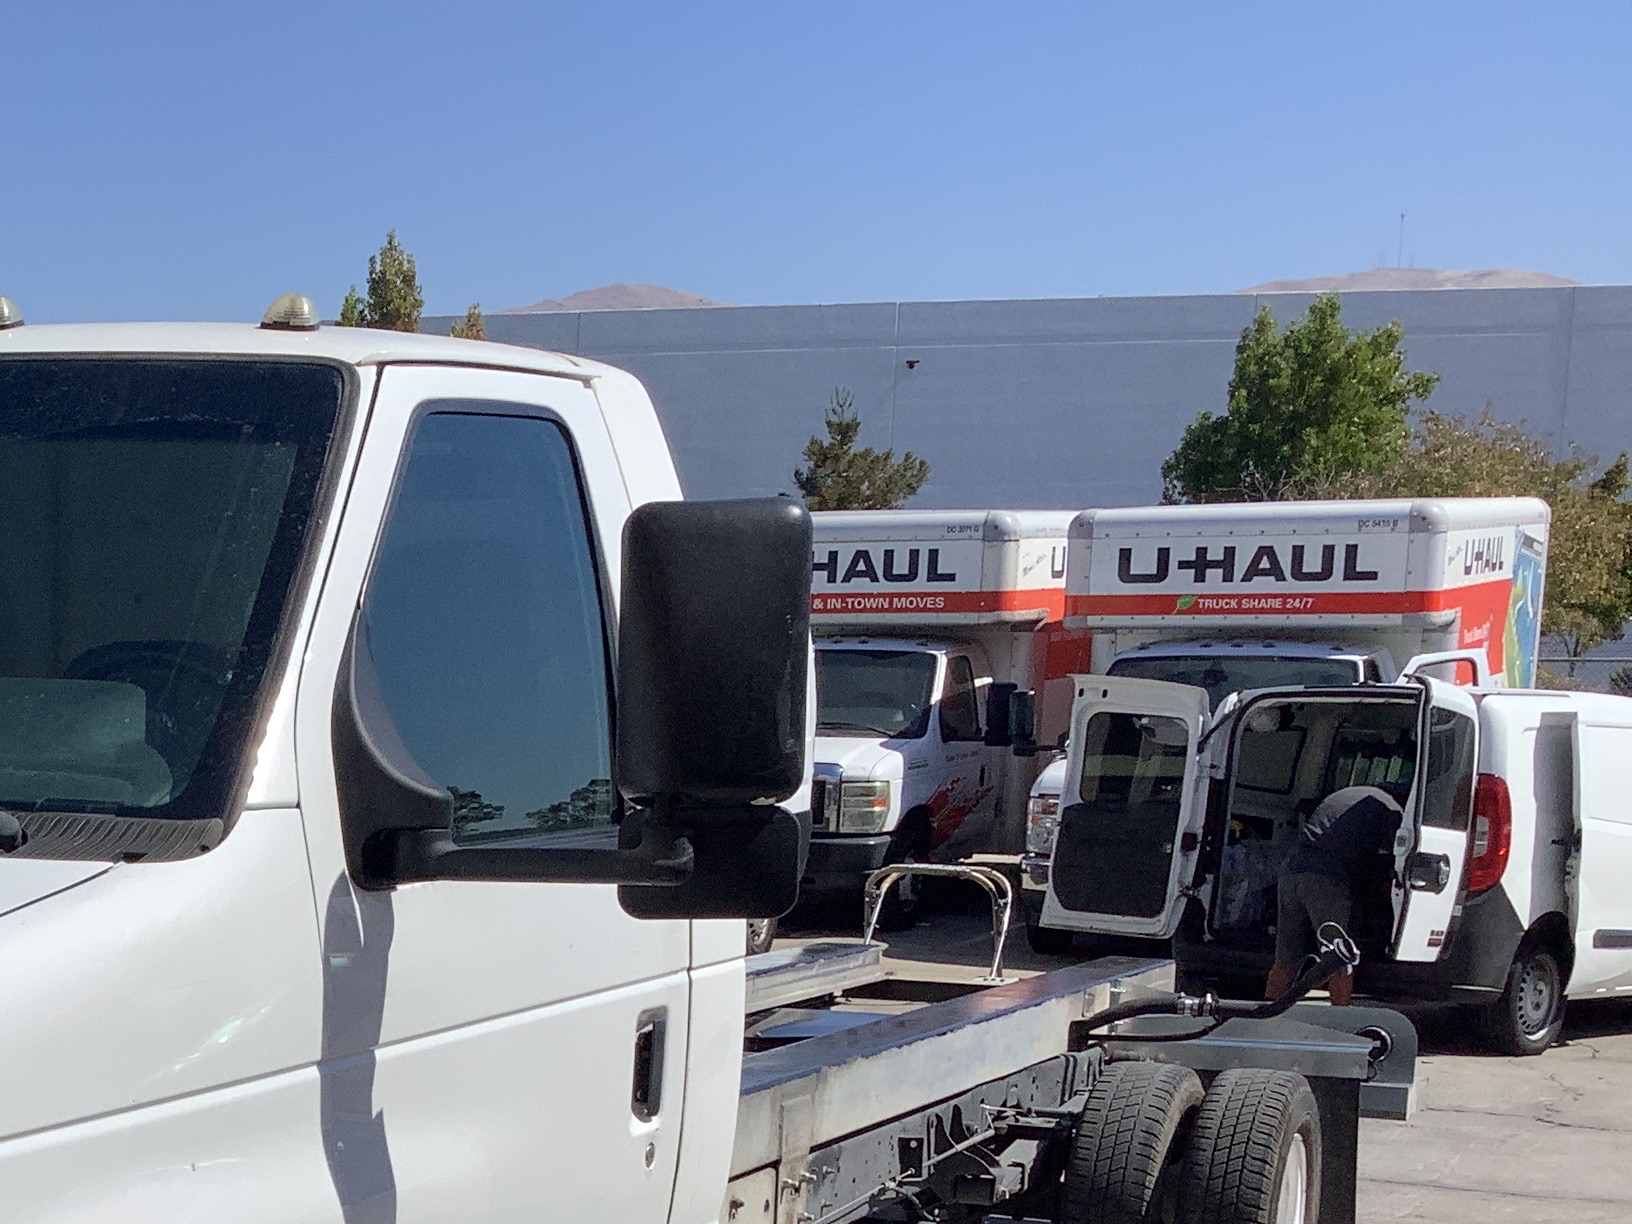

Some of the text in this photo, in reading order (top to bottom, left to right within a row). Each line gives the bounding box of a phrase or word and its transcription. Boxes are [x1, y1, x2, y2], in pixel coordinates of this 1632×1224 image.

[811, 548, 957, 584] HAUL
[1118, 543, 1379, 584] U-HAUL
[812, 596, 945, 610] & IN-TOWN MOVES
[1197, 596, 1314, 610] TRUCK SHARE 24/7
